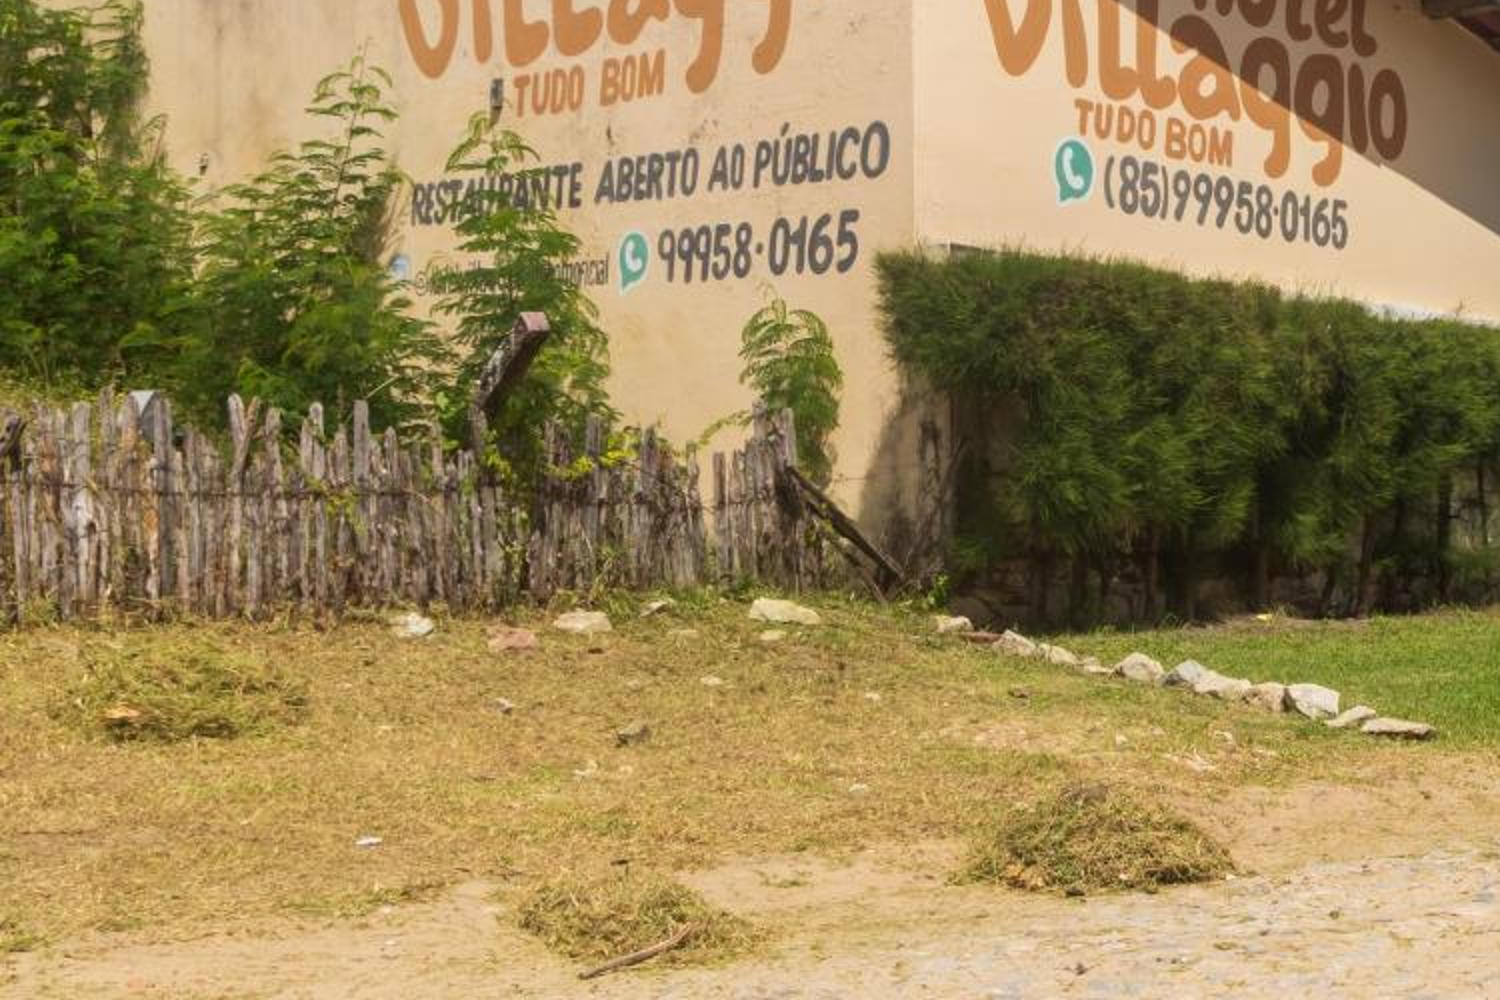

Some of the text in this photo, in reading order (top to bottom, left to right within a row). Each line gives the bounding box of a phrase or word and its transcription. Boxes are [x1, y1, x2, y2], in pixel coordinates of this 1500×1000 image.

[514, 49, 666, 118] TUDO BOM
[594, 150, 699, 204] ABERTO
[708, 148, 744, 191] AO
[753, 121, 891, 187] PÚBLICO
[1075, 98, 1233, 168] TUDO BOM
